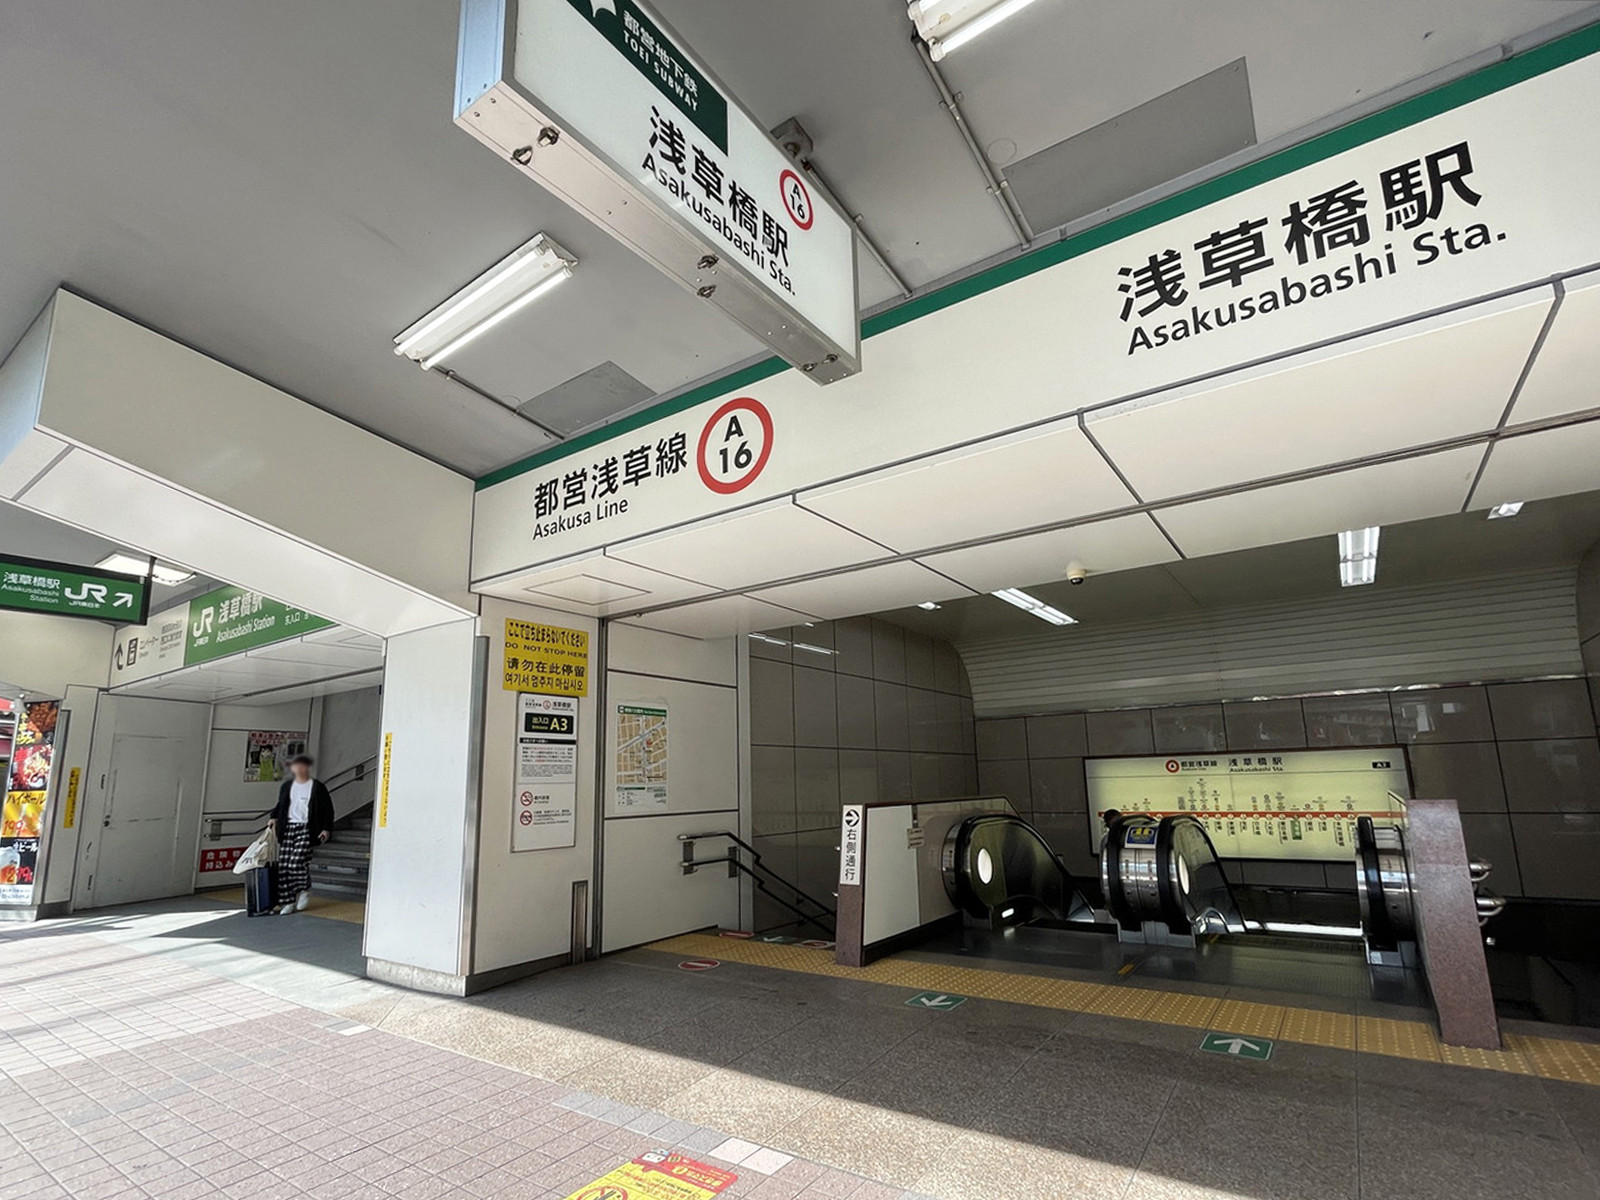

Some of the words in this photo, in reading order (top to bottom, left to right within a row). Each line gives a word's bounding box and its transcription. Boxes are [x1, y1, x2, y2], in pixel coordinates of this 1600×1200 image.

[623, 10, 698, 98] 都営地下鉄
[623, 31, 650, 64] TOEI
[653, 62, 698, 111] SUBWAY
[649, 105, 789, 267] 浅草橋駅
[791, 183, 801, 198] A
[789, 193, 806, 220] 16
[642, 155, 765, 270] Asakusabashi
[769, 261, 796, 295] Sta.
[1117, 140, 1482, 322] 浅草橋駅
[1128, 243, 1397, 355] Asakusabashi
[1413, 221, 1507, 267] Sta.
[724, 415, 744, 442] A
[718, 441, 751, 474] 16
[534, 431, 688, 519] 都営浅草線
[532, 510, 591, 540] Asakusa
[596, 497, 628, 523] Line
[1, 584, 59, 597] Asakusabashi
[3, 572, 61, 589] 浅草橋駅
[64, 582, 108, 604] JR
[29, 594, 59, 604] Station
[218, 592, 263, 624] 浅草橋駅
[193, 605, 214, 637] JR
[216, 618, 253, 644] Asakusabashi
[253, 614, 275, 632] Station
[505, 641, 519, 649] DO
[523, 644, 542, 652] NOT
[544, 647, 566, 656] STOP
[567, 651, 588, 659] HERE
[505, 672, 530, 687] 여기서
[507, 656, 586, 678] 请勿在此停留
[550, 718, 568, 731] A3
[1229, 756, 1283, 766] 浅草橋駅
[7, 793, 46, 806] ハイボール
[844, 828, 857, 881] 右側通行
